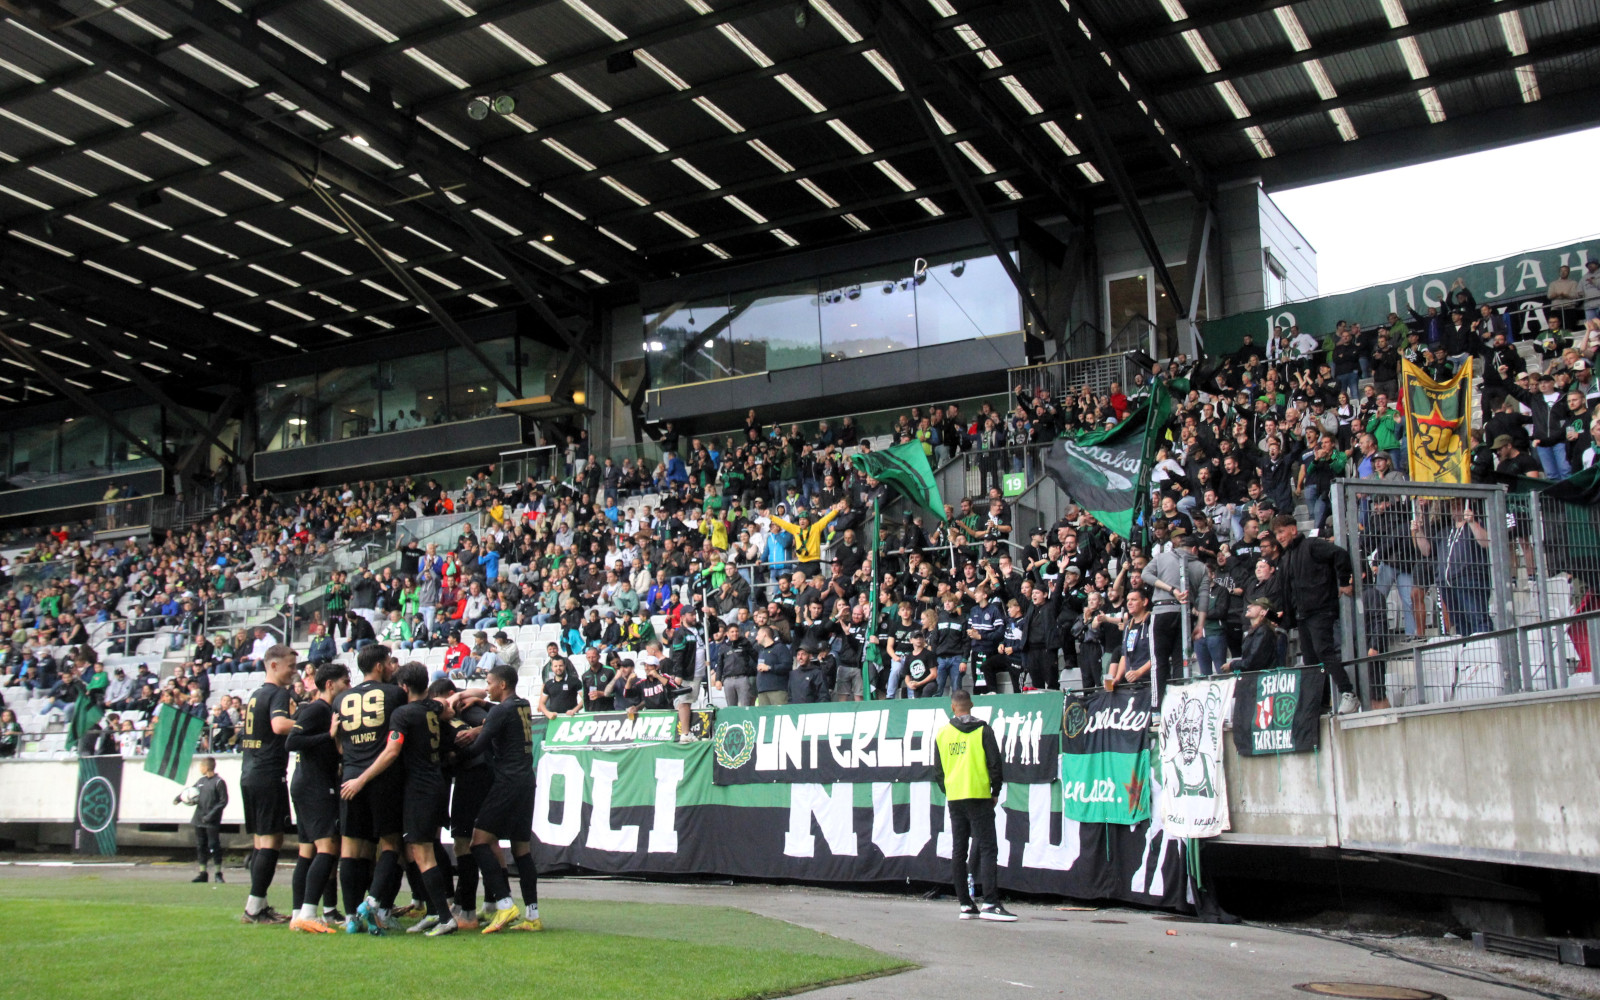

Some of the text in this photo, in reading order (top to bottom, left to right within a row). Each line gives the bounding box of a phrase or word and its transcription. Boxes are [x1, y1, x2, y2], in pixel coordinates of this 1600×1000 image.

[1005, 478, 1022, 492] 19
[246, 697, 257, 735] 6
[340, 688, 386, 732] 99
[350, 731, 377, 745] YILMAZ
[552, 716, 675, 742] ASPIRANTE
